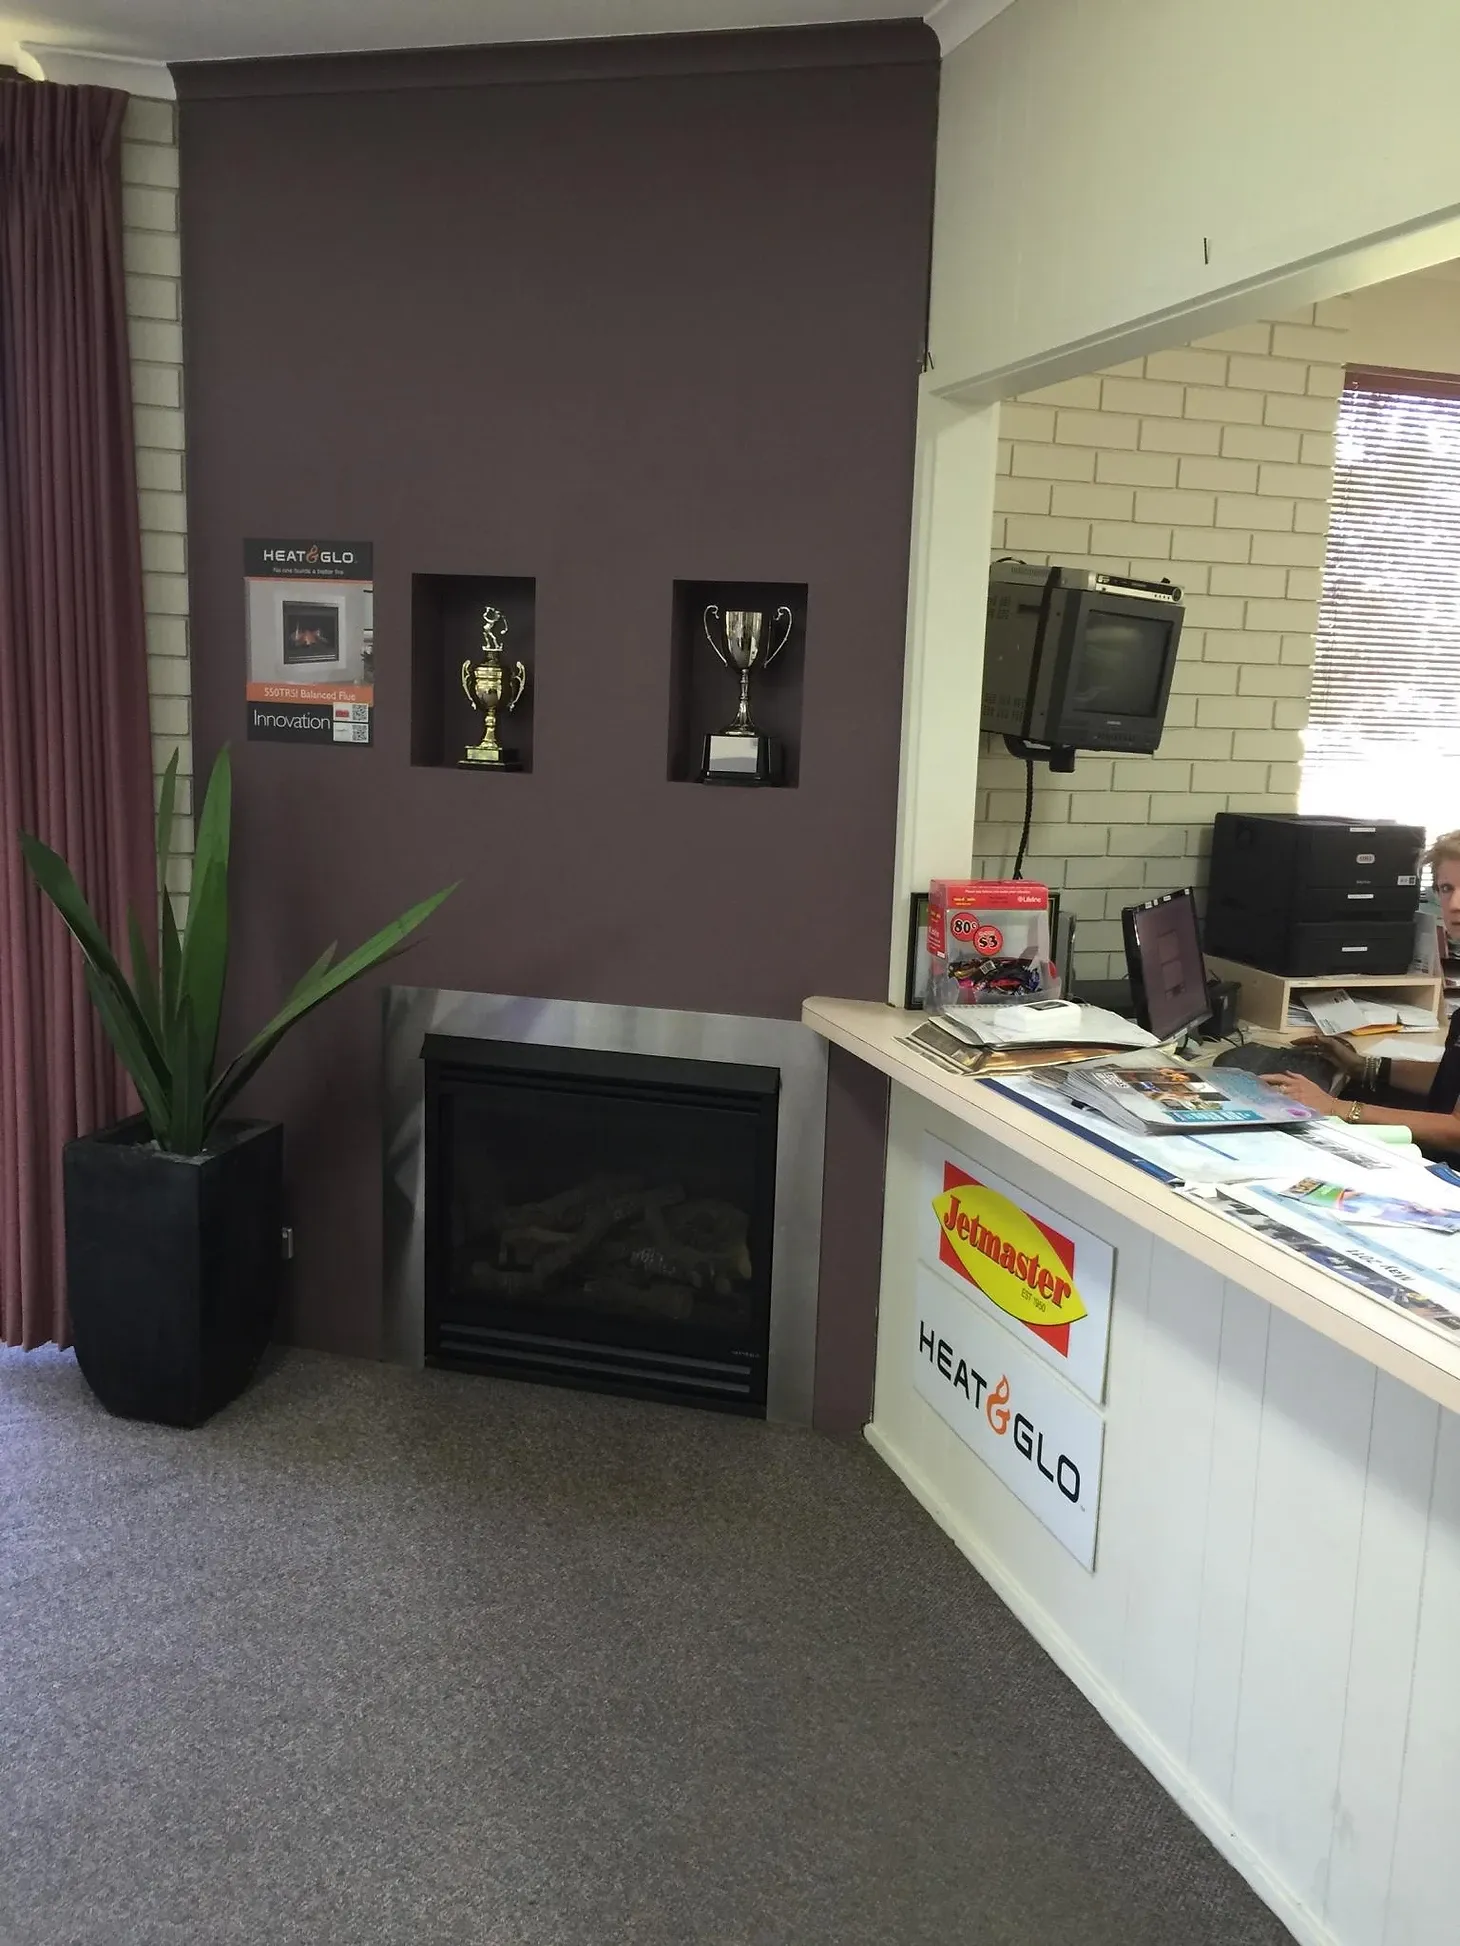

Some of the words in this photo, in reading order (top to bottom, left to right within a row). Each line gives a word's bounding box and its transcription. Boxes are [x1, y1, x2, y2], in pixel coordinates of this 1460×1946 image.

[300, 689, 336, 701] Balanced
[338, 691, 356, 702] Flue
[254, 709, 330, 730] Innovation
[978, 935, 998, 949] $3
[943, 1194, 1072, 1309] Jetmaster
[1021, 1287, 1033, 1301] EST
[1033, 1296, 1047, 1313] 1950
